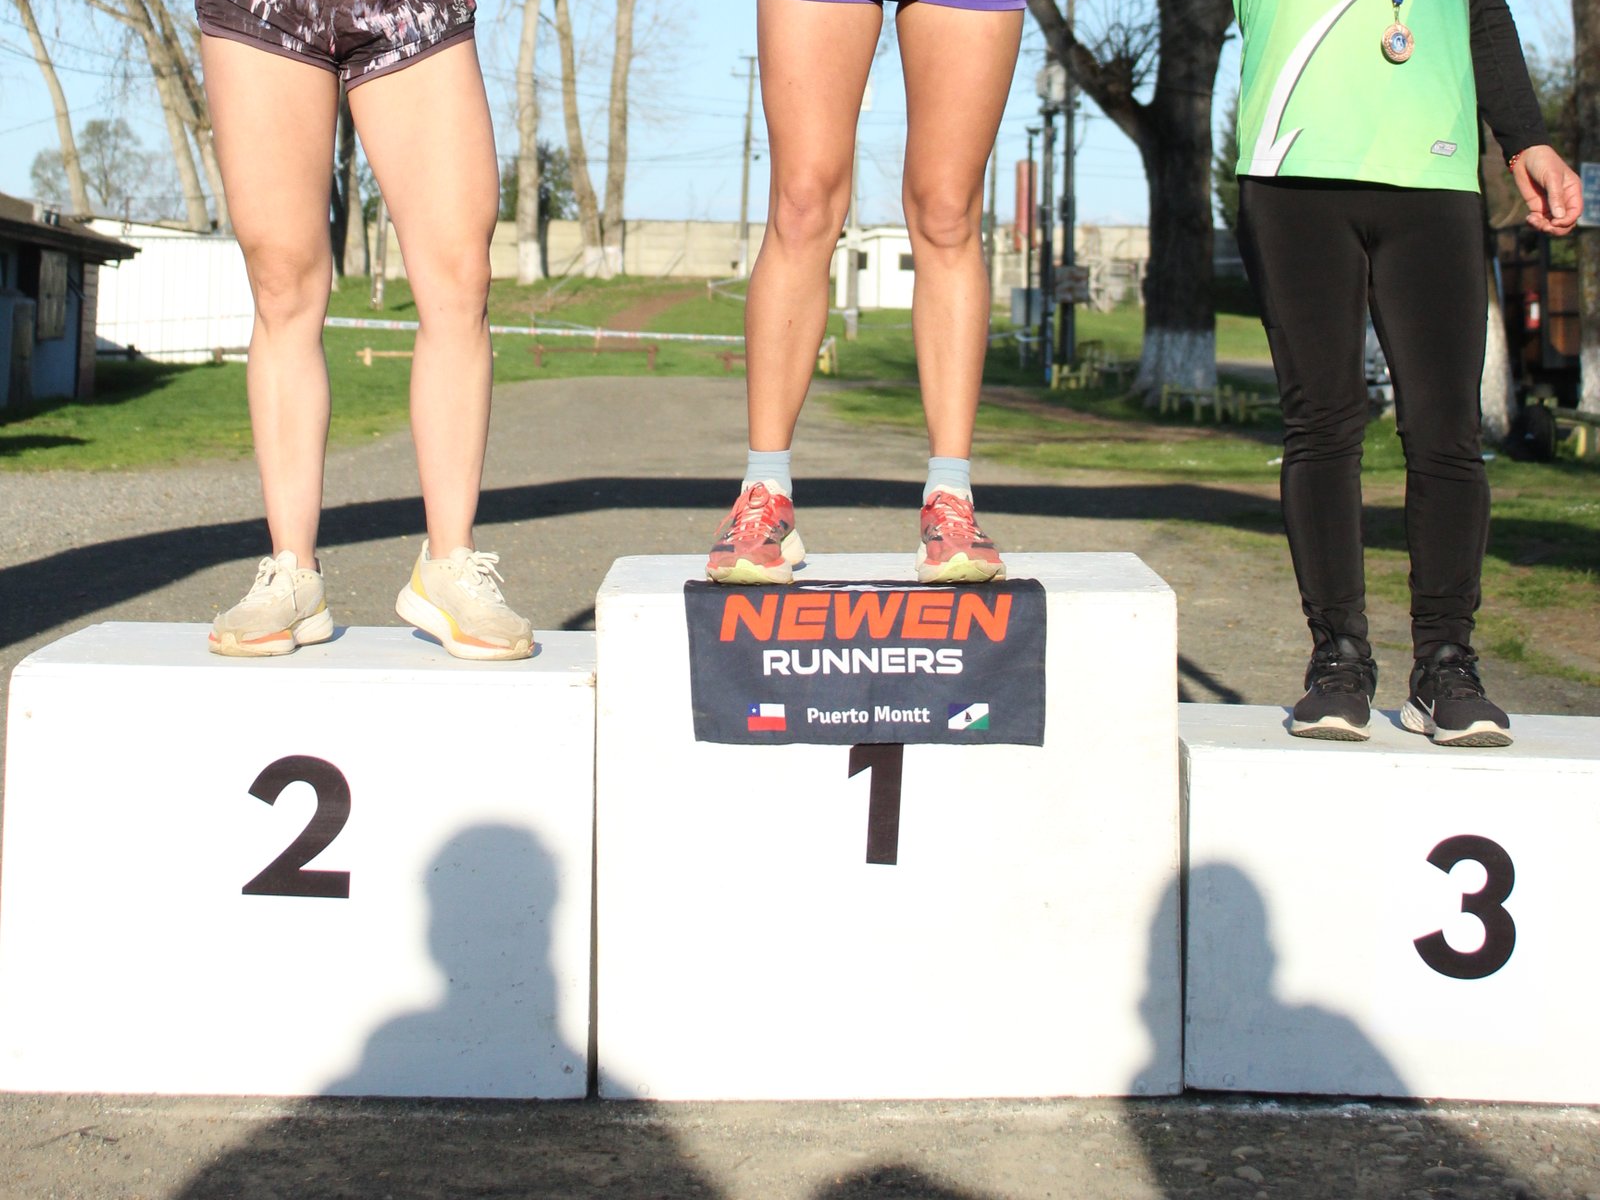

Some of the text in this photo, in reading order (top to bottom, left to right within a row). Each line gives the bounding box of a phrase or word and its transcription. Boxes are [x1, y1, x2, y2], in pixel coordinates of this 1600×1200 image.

[719, 592, 1013, 642] NEWEN
[763, 647, 964, 676] RUNNERS
[807, 705, 931, 725] Puerto Montt
[241, 755, 351, 899] 2
[848, 743, 904, 866] 1
[1413, 835, 1516, 980] 3
